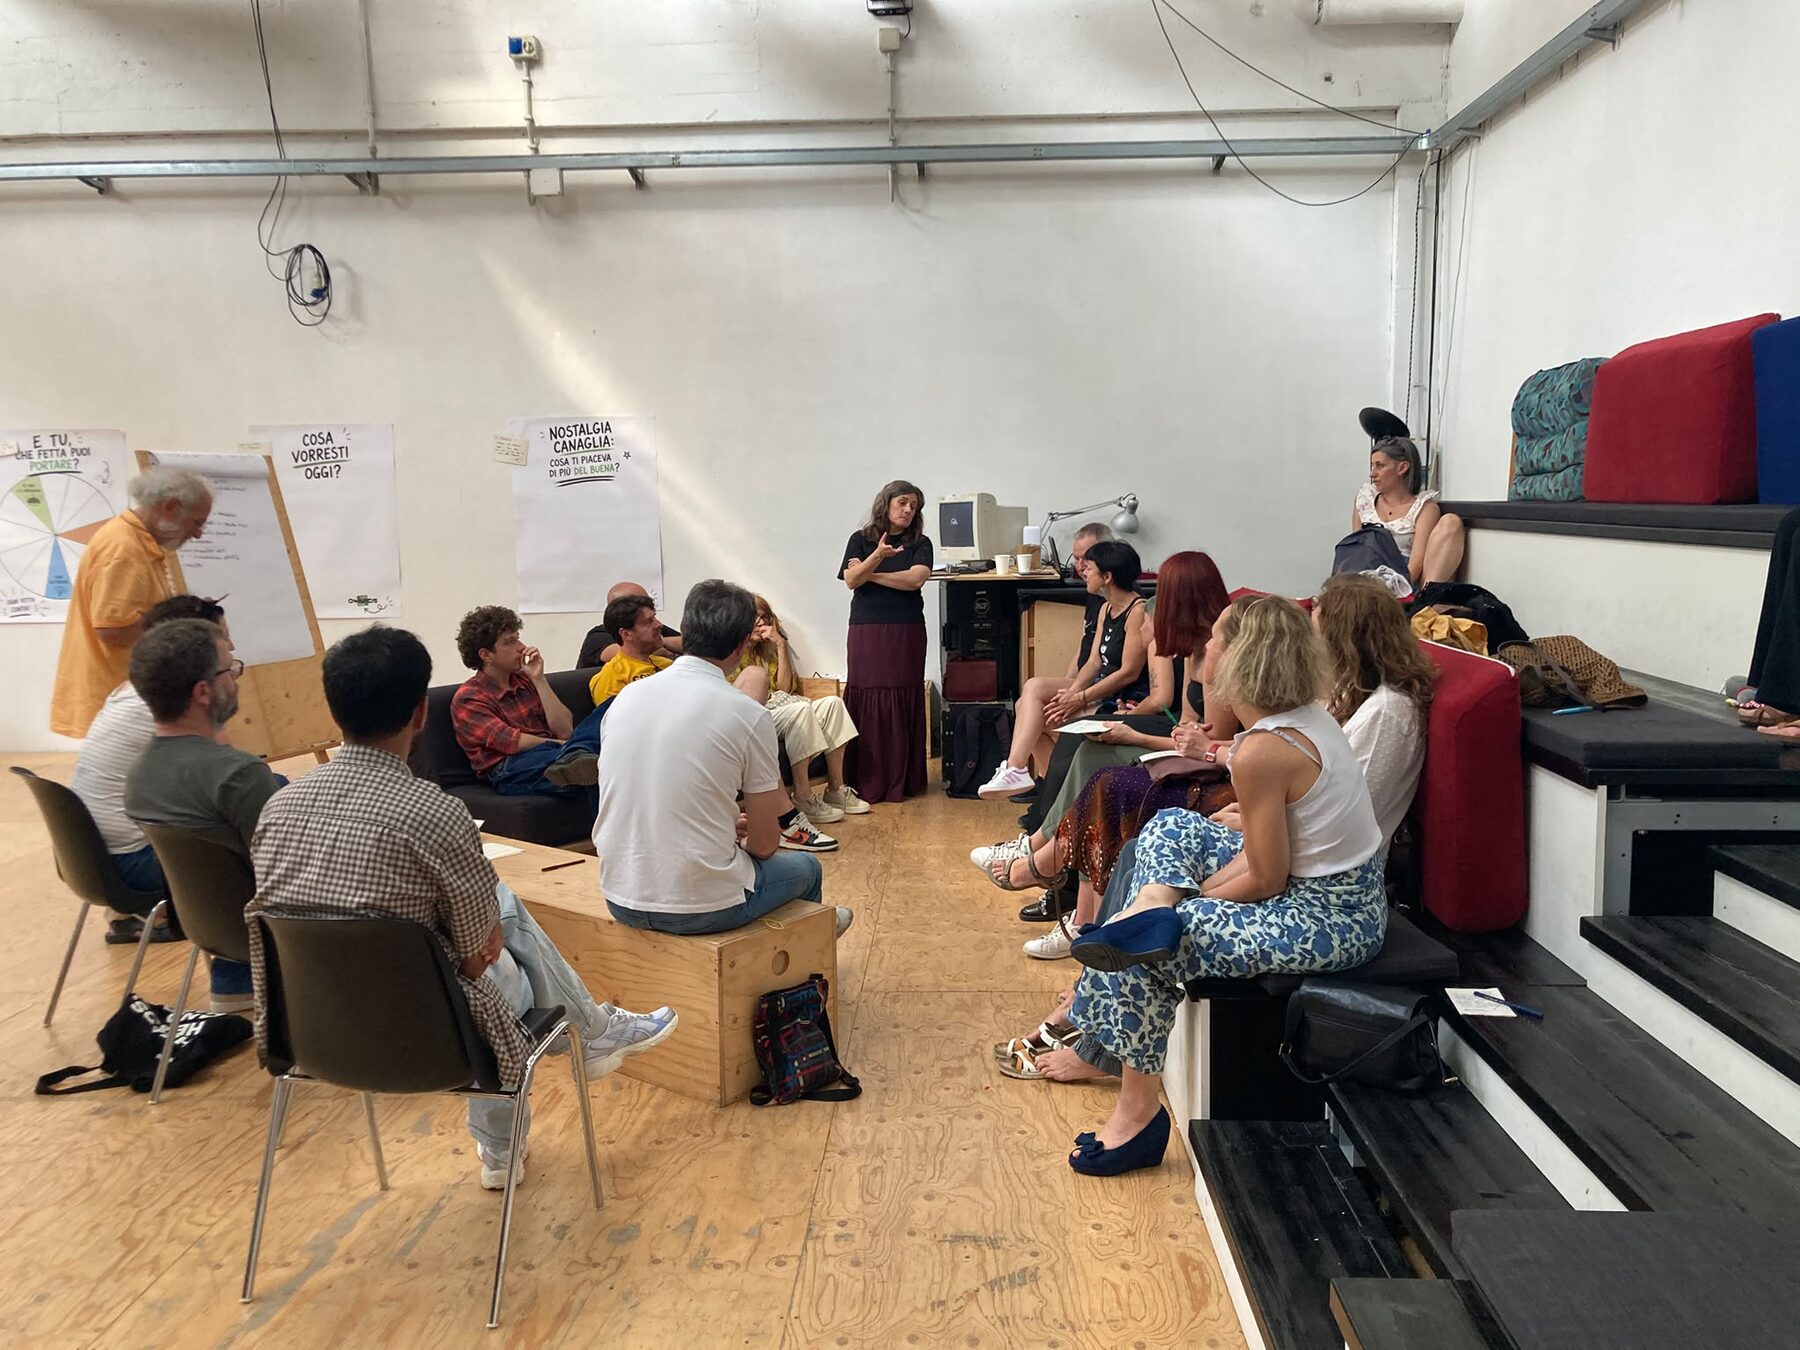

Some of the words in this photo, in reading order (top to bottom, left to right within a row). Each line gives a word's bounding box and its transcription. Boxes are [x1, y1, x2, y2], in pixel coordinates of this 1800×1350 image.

[549, 421, 612, 440] NOSTALGIA
[33, 435, 42, 448] E
[49, 433, 71, 447] TU,
[302, 431, 333, 446] COSA
[554, 435, 614, 453] CANAGLIA:
[15, 449, 33, 460] CHE
[38, 448, 67, 459] FETTA
[71, 448, 91, 457] PUOI
[291, 446, 348, 463] VORRESTI
[550, 458, 569, 467] COSA
[572, 457, 579, 465] TI
[581, 454, 612, 464] PIACEVA
[29, 458, 79, 471] PORTARE?
[304, 464, 341, 479] OGGI?
[560, 467, 571, 476] PIÙ
[574, 467, 588, 475] DEL
[590, 462, 620, 474] BUENA?
